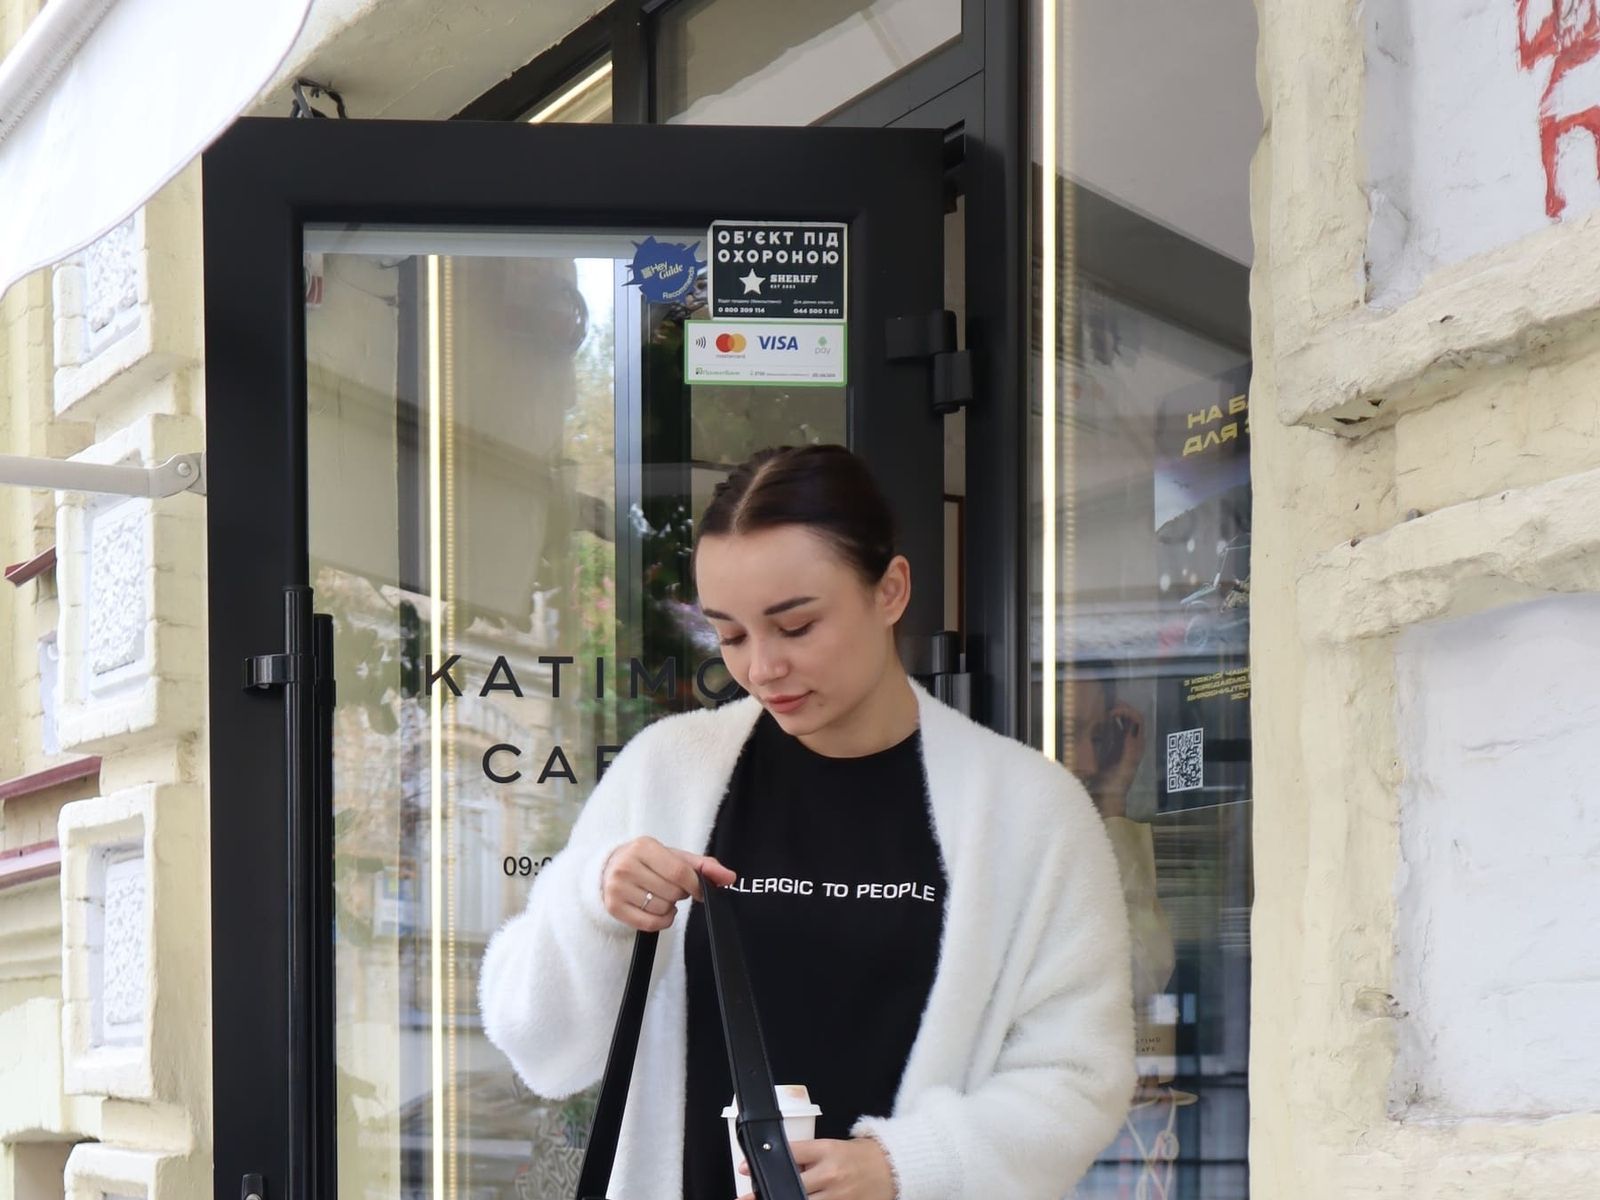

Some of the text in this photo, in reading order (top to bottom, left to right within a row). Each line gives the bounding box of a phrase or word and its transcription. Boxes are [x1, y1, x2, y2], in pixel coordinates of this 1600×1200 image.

[718, 230, 839, 247] ОБ'ЄКТ ПІД
[717, 249, 839, 264] ОХОРОНОЮ
[650, 260, 668, 274] Hey
[659, 264, 684, 280] Guide
[770, 274, 819, 283] SHERIFF
[756, 335, 799, 351] VISA
[1187, 405, 1223, 429] НА
[1228, 394, 1249, 415] Б
[1182, 422, 1238, 456] ДЛЯ
[424, 654, 742, 701] KATIMO
[482, 743, 625, 784] CAF
[822, 883, 849, 897] TO
[856, 882, 936, 902] PEOPLE
